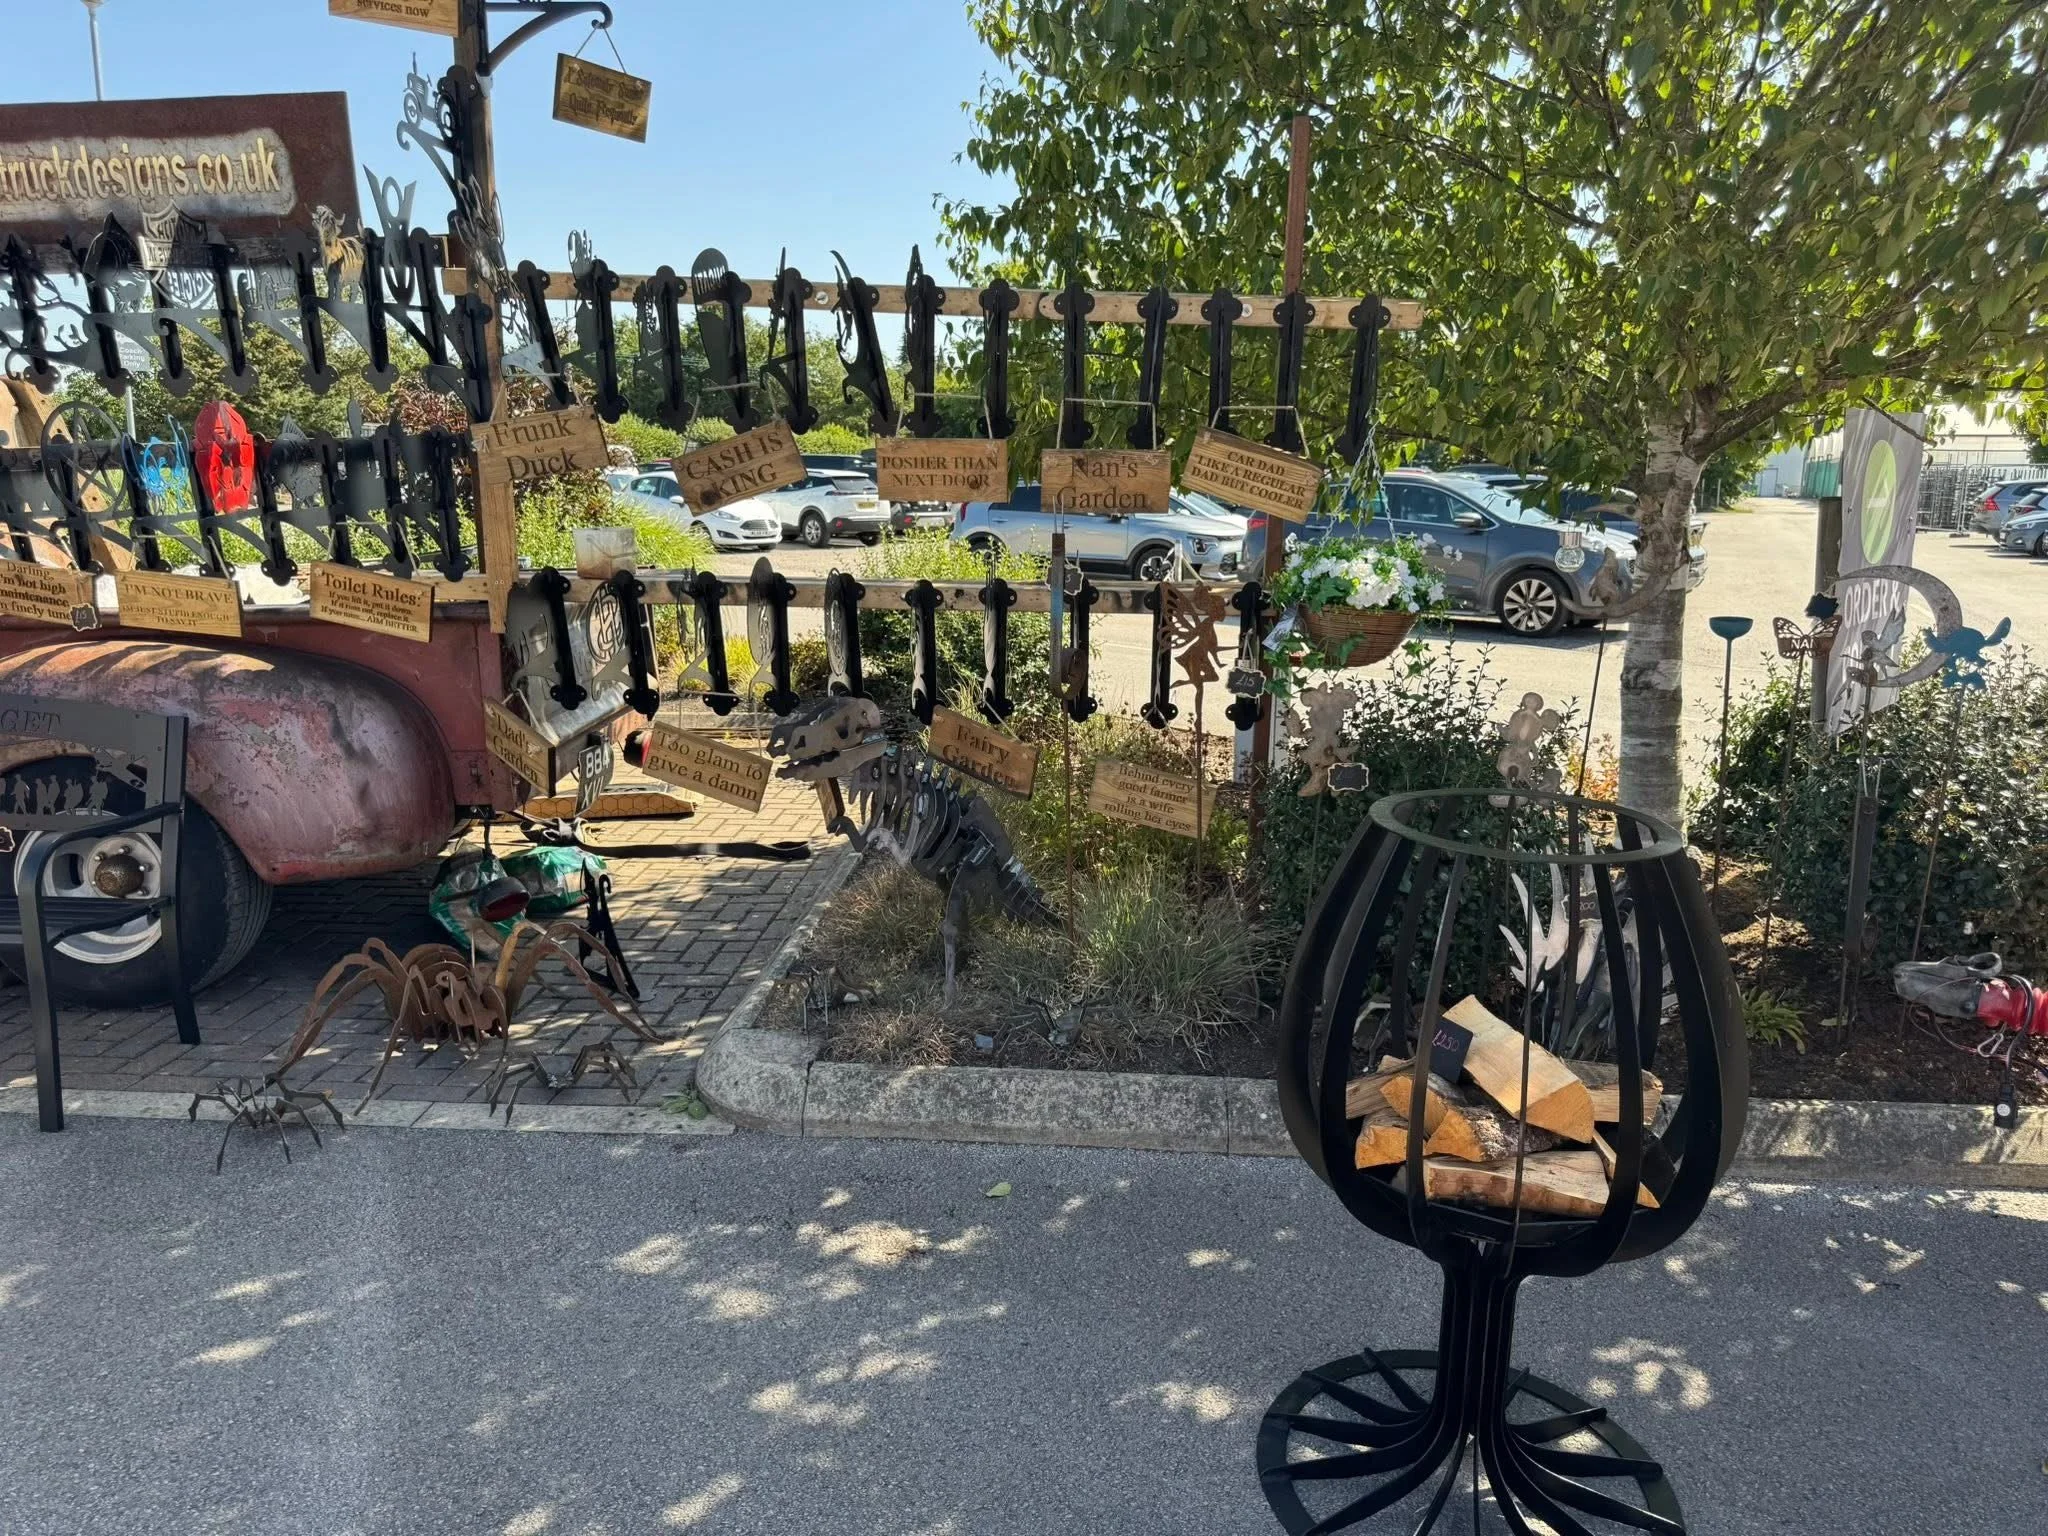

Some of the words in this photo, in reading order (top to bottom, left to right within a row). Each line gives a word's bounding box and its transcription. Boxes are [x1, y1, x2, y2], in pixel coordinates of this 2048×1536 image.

[405, 6, 430, 18] now
[490, 411, 577, 447] Frunk
[505, 447, 582, 480] Duck
[686, 442, 754, 479] CASH
[755, 431, 783, 455] IS
[882, 456, 947, 470] POSHER
[951, 456, 998, 470] THAN
[1068, 455, 1138, 478] Nan's
[1227, 451, 1254, 467] CAR
[1257, 460, 1285, 476] DAD
[711, 462, 777, 498] KING
[892, 473, 937, 486] NEXT
[942, 474, 990, 487] DOOR
[1191, 466, 1218, 482] DAD
[1221, 475, 1248, 491] BUT
[1249, 486, 1304, 510] COOLER
[1198, 455, 1231, 473] LIKE
[1230, 465, 1239, 477] A
[1242, 469, 1306, 497] REGULAR
[1056, 486, 1147, 509] Garden
[40, 579, 66, 595] high
[125, 583, 146, 595] I'M
[152, 586, 180, 599] NOT
[185, 589, 233, 604] BRAVE
[323, 571, 367, 594] Toilet
[372, 582, 421, 607] Rules:
[12, 601, 44, 617] finely
[47, 607, 72, 620] tune
[1844, 579, 1888, 629] ORDER
[493, 735, 538, 784] Garden
[657, 730, 690, 756] Too
[694, 748, 740, 773] glam
[746, 763, 763, 781] to
[957, 724, 1010, 765] Fairy
[586, 743, 611, 779] 884
[943, 744, 1016, 788] Garden
[647, 754, 688, 777] give
[692, 771, 703, 784] a
[708, 773, 757, 801] damn
[1119, 763, 1159, 784] Behind
[1161, 779, 1194, 794] every
[1119, 780, 1147, 793] good
[1150, 786, 1190, 804] farmer
[1104, 802, 1141, 821] rolling
[1144, 810, 1162, 824] her
[1165, 820, 1191, 832] eyes
[1126, 794, 1136, 804] is
[1149, 799, 1175, 814] wife
[1432, 1029, 1459, 1052] £250
